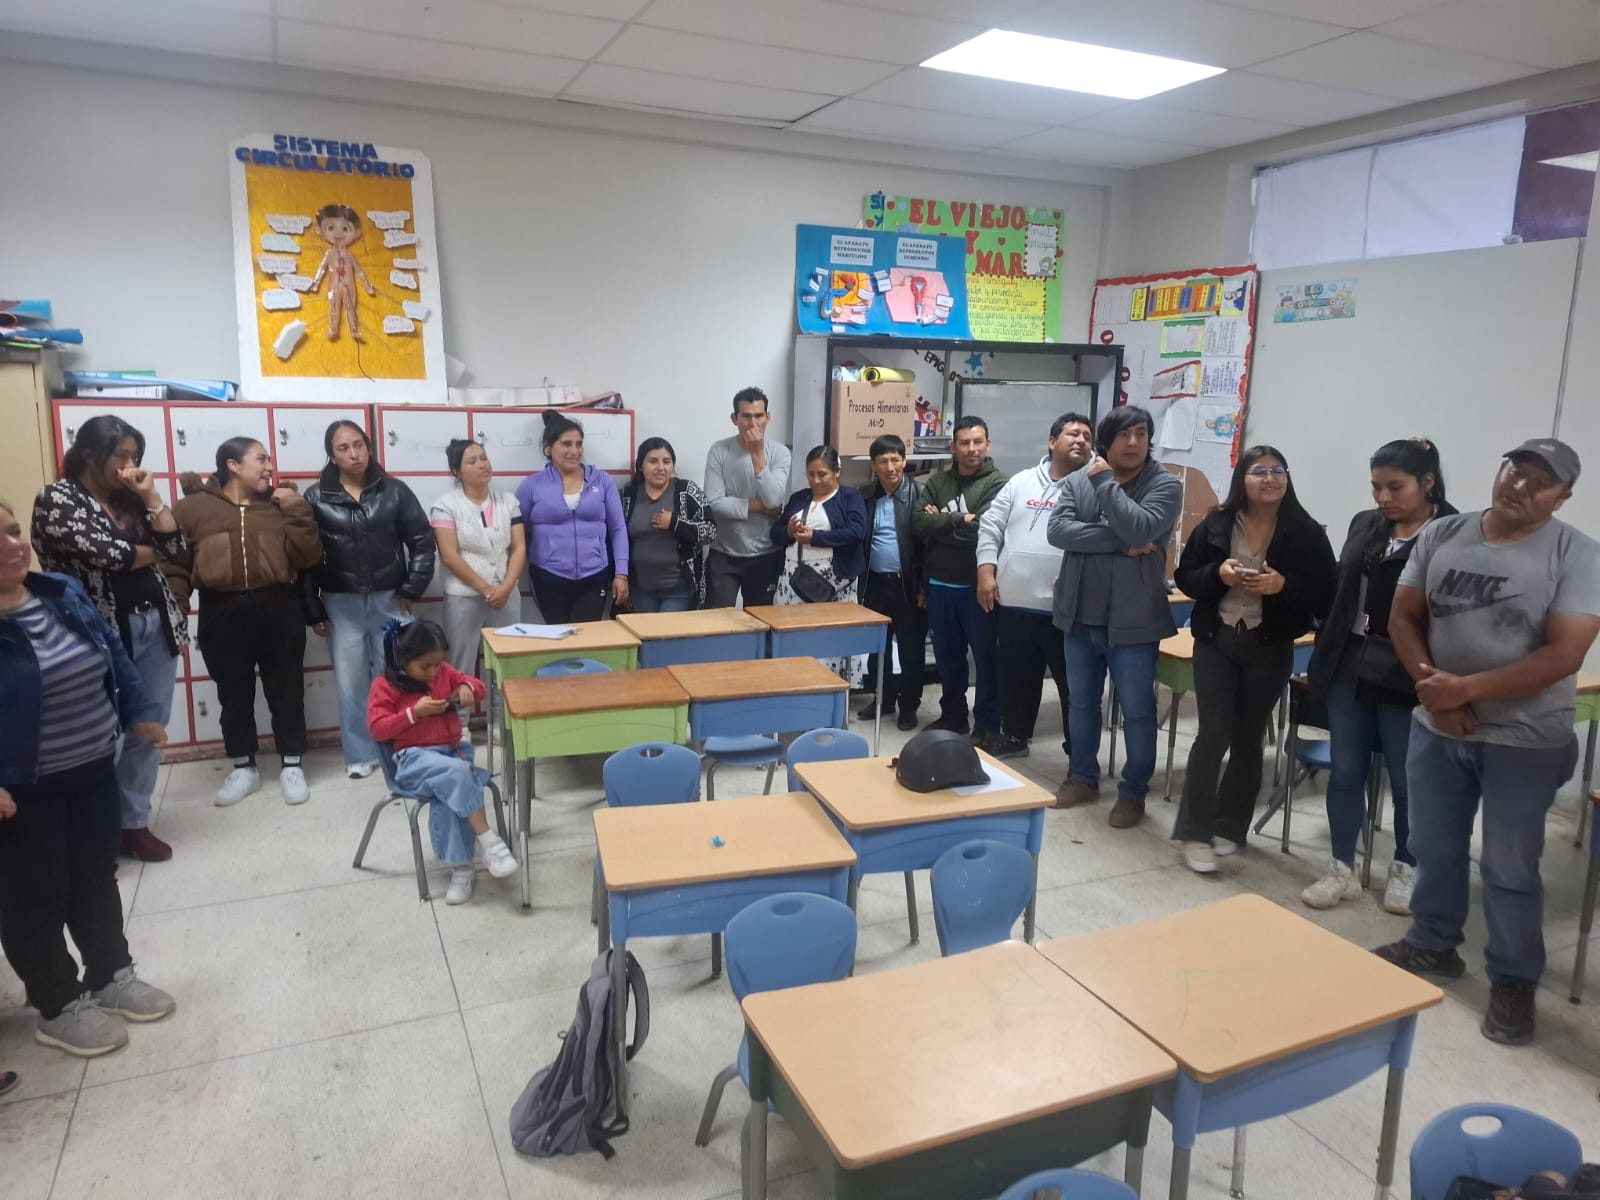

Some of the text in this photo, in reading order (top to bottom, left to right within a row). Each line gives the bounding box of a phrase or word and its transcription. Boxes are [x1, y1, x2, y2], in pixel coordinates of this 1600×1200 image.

[273, 134, 378, 159] SISTEMA
[235, 147, 415, 178] CIRCULATORIO
[909, 198, 1026, 230] EL VIEJO
[975, 249, 1026, 276] MAR
[1304, 283, 1324, 296] LEO
[848, 399, 909, 414] Procesos Alimentarios
[1437, 568, 1509, 602] NIKE
